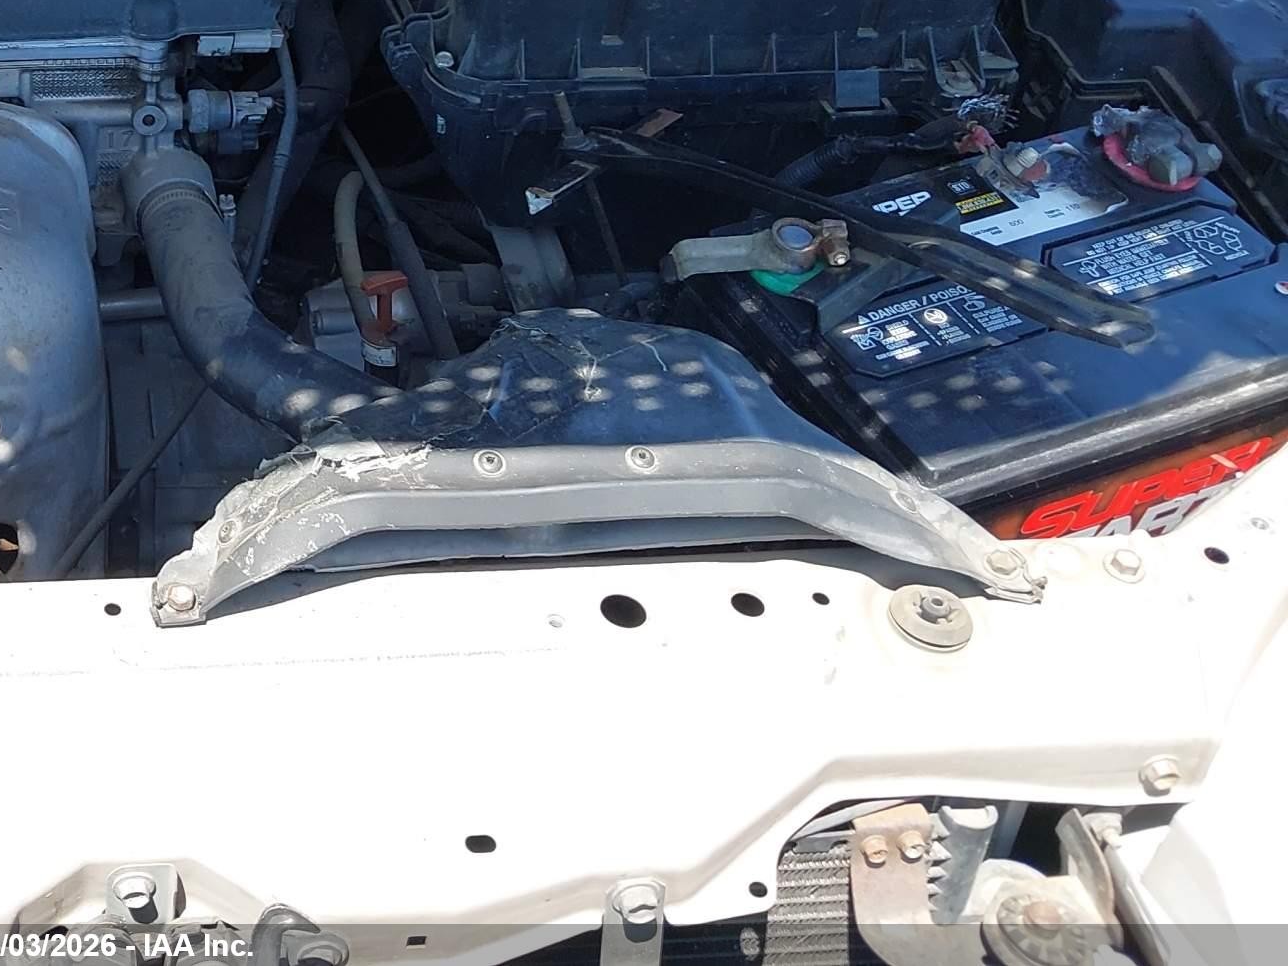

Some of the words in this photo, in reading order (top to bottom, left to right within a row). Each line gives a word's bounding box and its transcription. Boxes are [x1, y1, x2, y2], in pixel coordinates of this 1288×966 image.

[868, 298, 920, 322] DANGER
[930, 284, 972, 303] POISO
[1021, 437, 1273, 537] SUPER
